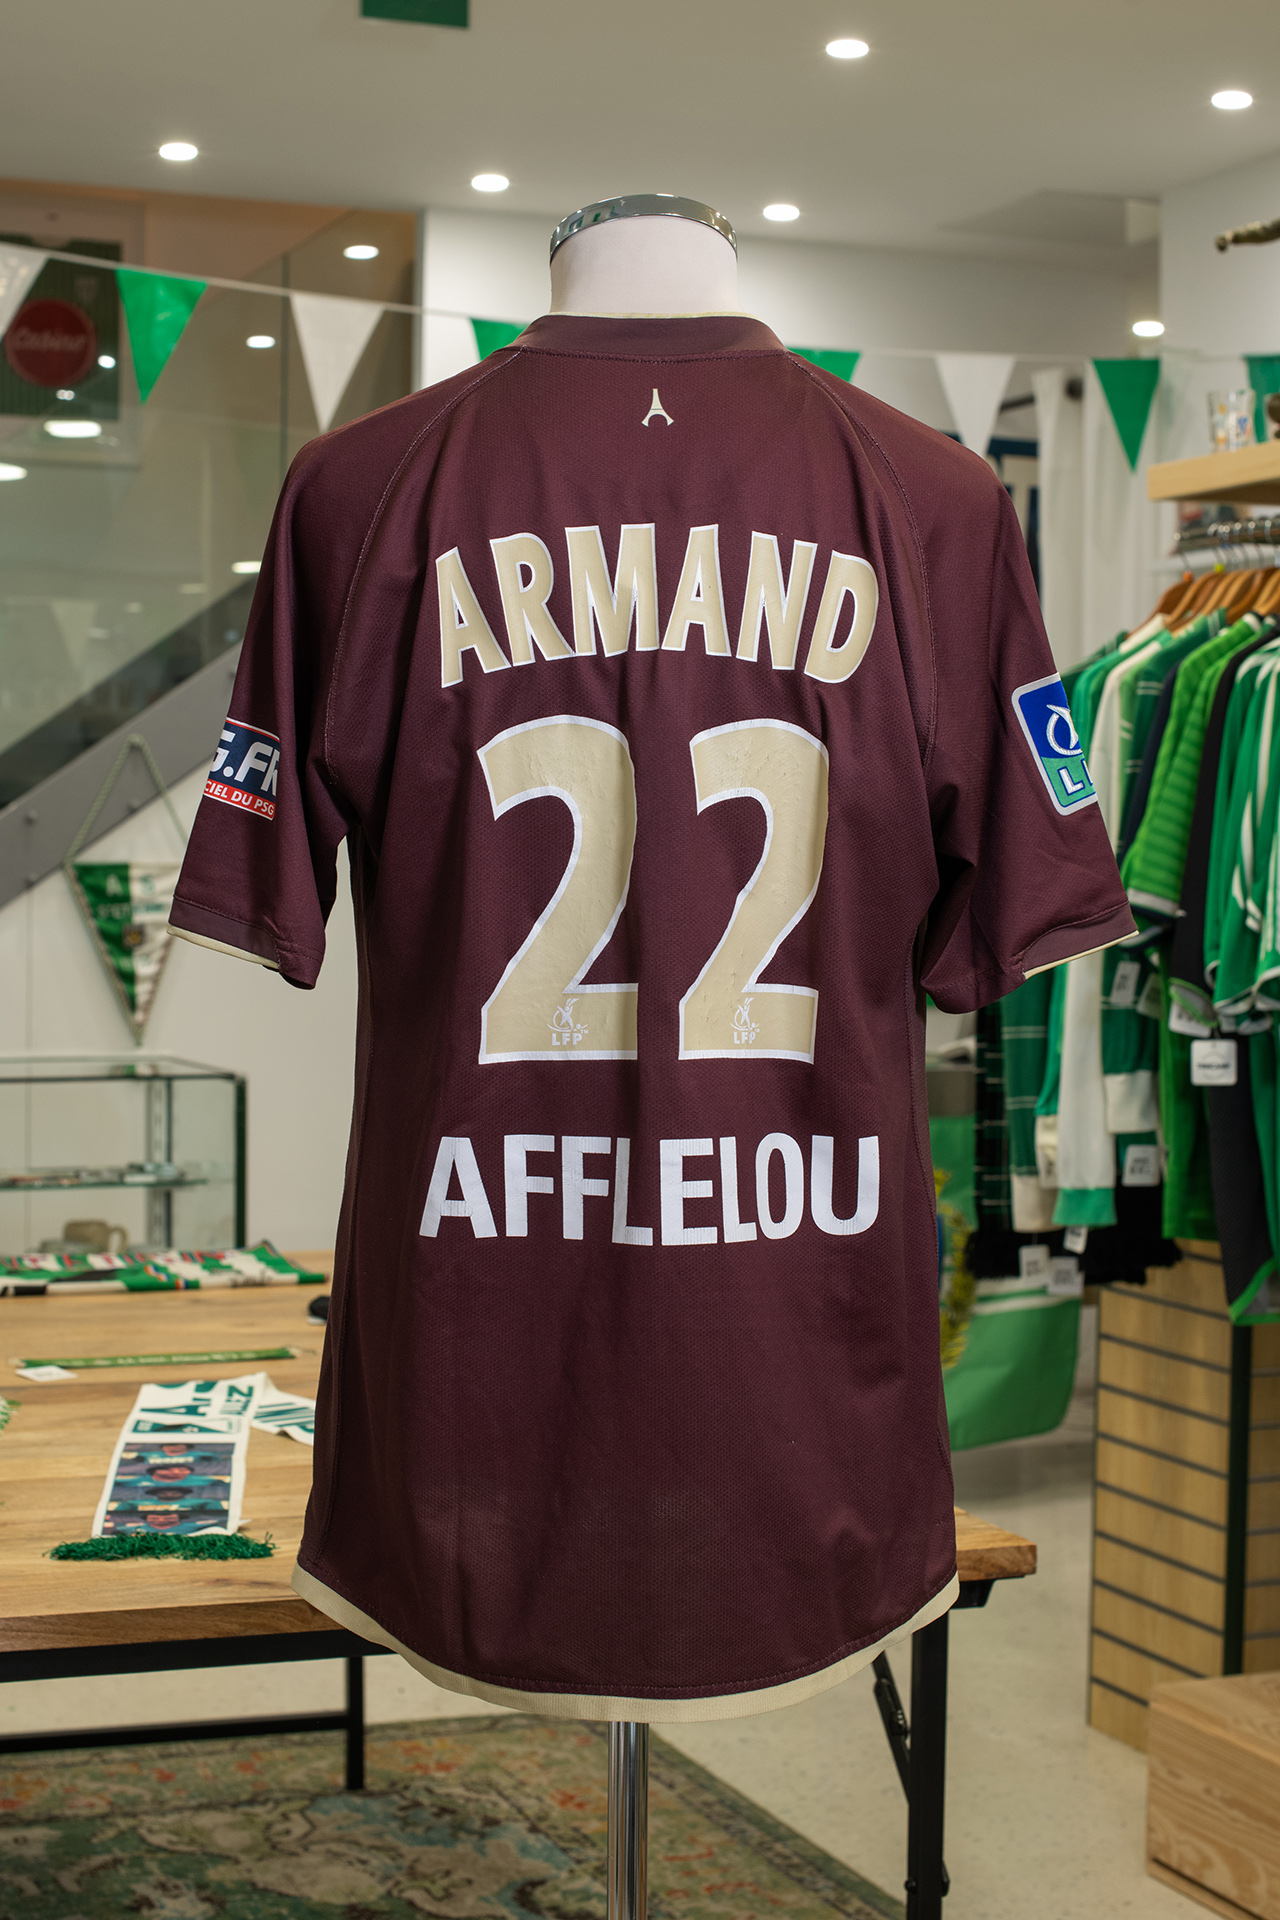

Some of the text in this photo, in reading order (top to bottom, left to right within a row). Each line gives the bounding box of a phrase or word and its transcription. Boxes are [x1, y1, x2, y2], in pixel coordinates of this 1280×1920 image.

[436, 523, 879, 688] ARMAND
[204, 780, 275, 816] CIEL DU PSG
[477, 715, 829, 1064] 22
[552, 1033, 583, 1046] LFP
[734, 1031, 756, 1044] LFP
[419, 1133, 879, 1246] AFFLELOU
